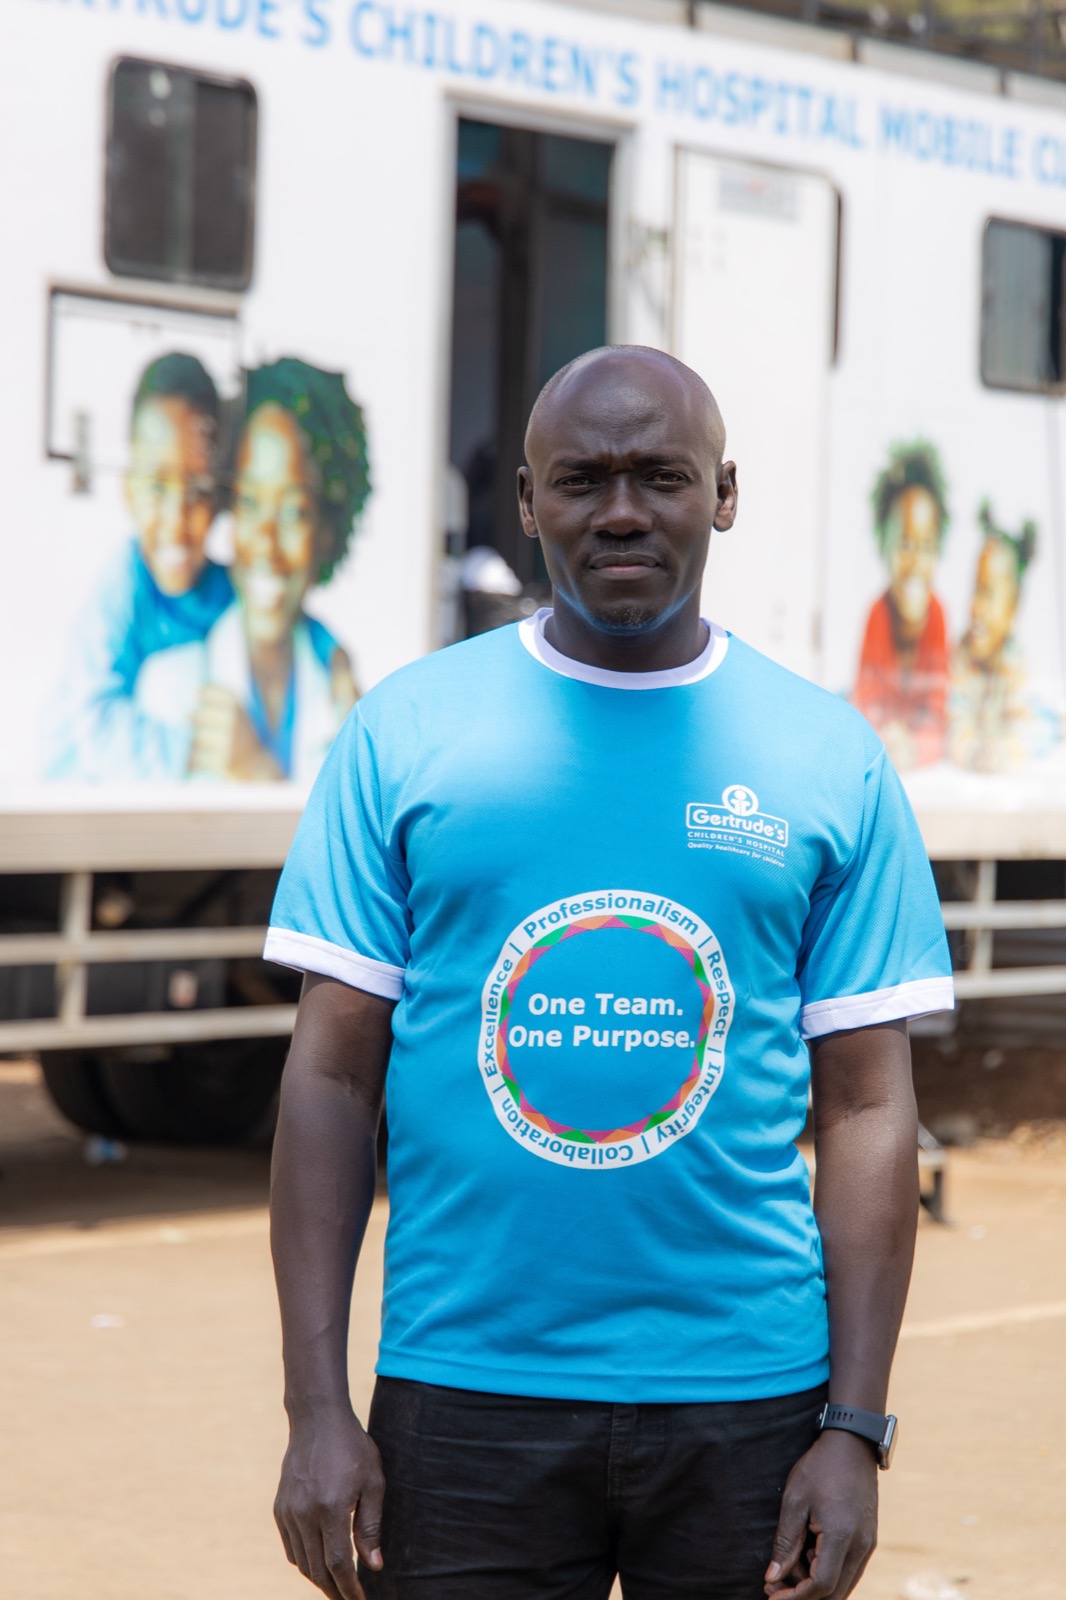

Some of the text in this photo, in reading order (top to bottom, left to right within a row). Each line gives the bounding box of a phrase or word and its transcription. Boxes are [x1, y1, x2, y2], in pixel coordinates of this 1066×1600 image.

[350, 1, 639, 106] CHILDREN'S
[656, 61, 864, 149] HOSPITAL
[880, 106, 1019, 181] MOBILE
[693, 809, 785, 841] Gertrude's
[687, 831, 785, 858] CHILDREN'S HOSPITAL
[687, 842, 714, 850] Quality
[715, 843, 751, 856] healthcare
[751, 851, 762, 860] for
[528, 993, 683, 1016] One Team.
[484, 893, 731, 1164] Professionalism Respect Integrity Collaboration Excellence
[508, 1025, 695, 1052] One Purpose.
